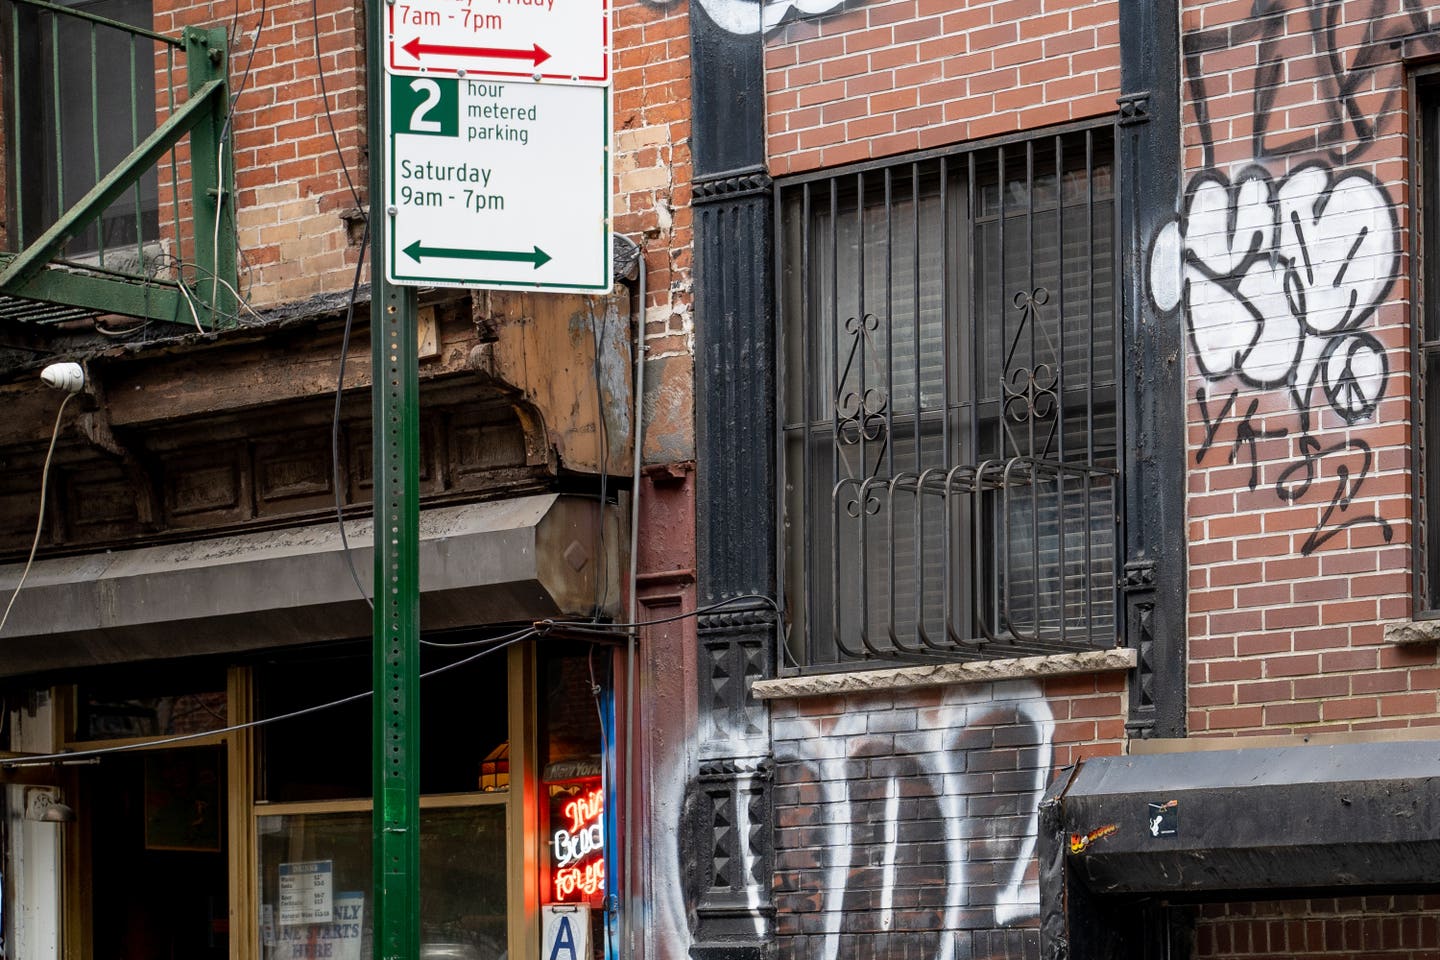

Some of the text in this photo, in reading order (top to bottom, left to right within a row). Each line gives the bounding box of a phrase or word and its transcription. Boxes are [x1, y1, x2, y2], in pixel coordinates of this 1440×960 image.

[400, 6, 440, 26] 7am
[461, 9, 502, 33] 7pm
[468, 81, 504, 98] hour
[409, 78, 441, 133] 2
[468, 104, 537, 121] metered
[468, 125, 529, 145] parking
[401, 159, 492, 187] Saturday
[401, 186, 442, 207] 9am
[463, 190, 505, 213] 7pm
[554, 813, 604, 868] Bud
[555, 868, 584, 901] for
[333, 904, 361, 920] NLY
